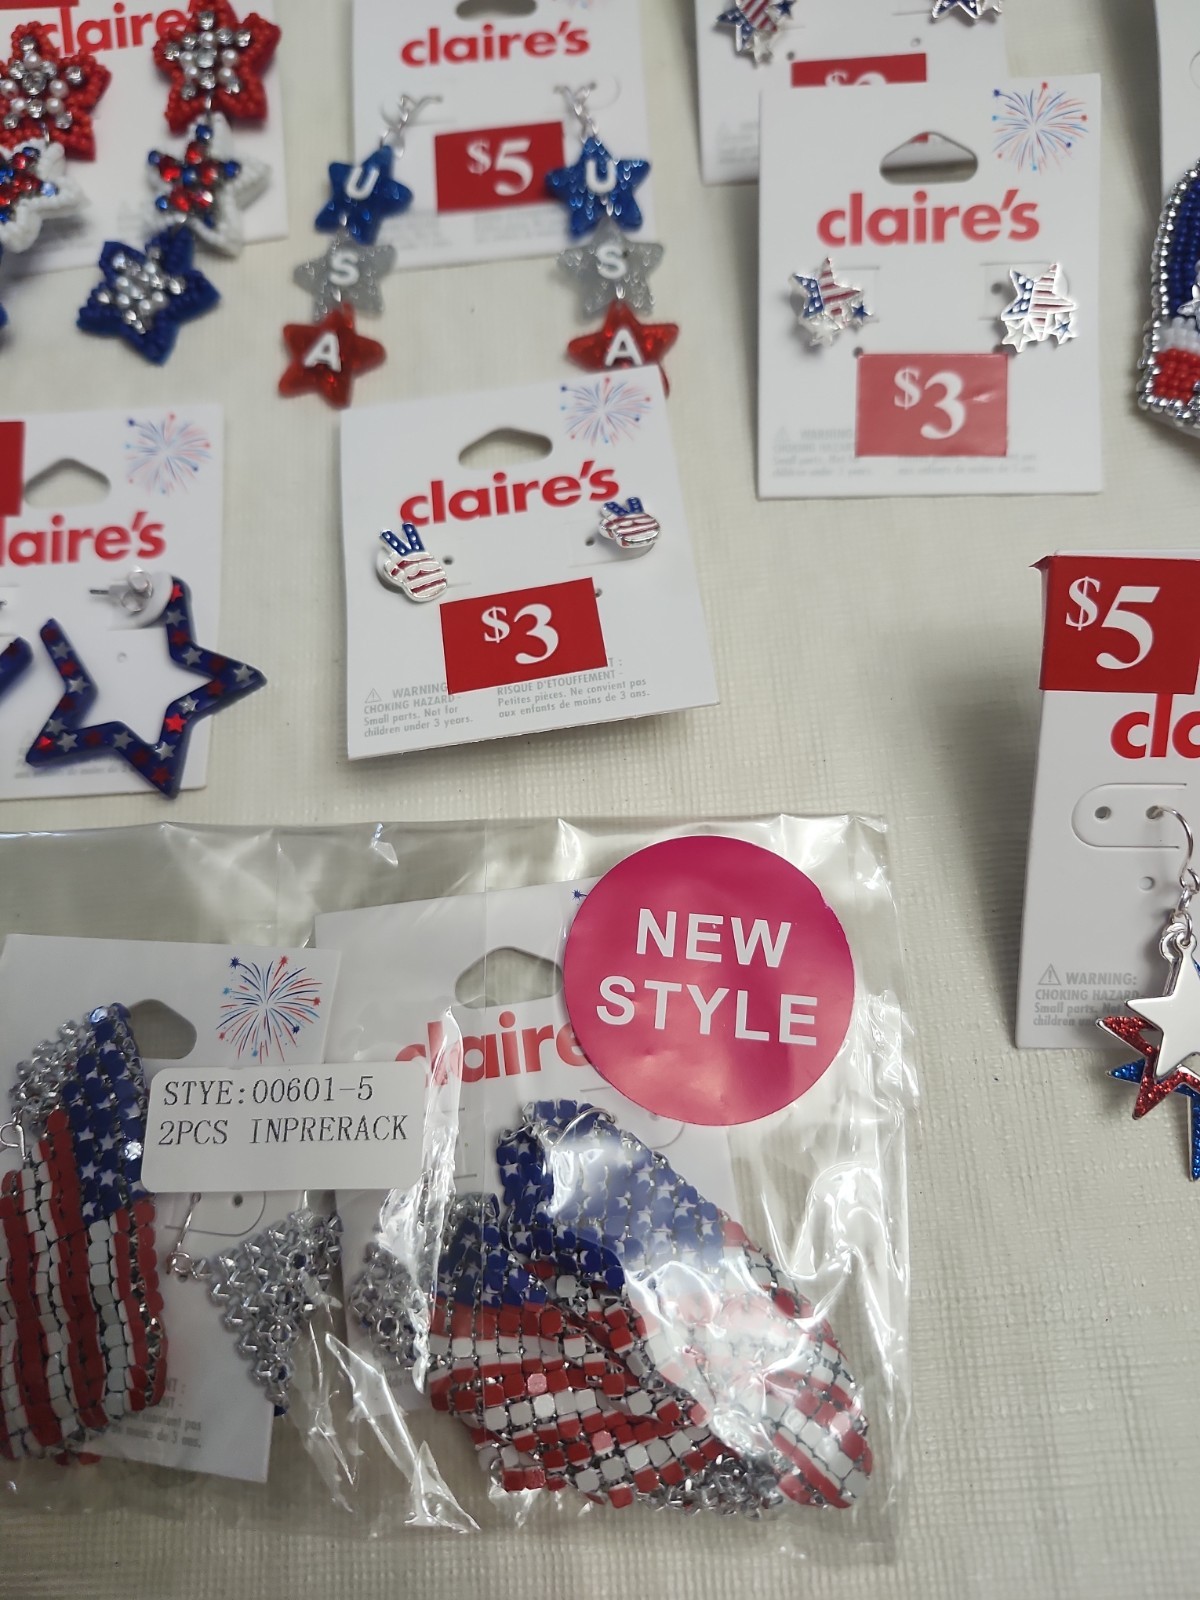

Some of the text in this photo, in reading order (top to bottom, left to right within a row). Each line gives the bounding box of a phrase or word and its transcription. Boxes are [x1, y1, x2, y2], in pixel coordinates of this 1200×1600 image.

[400, 21, 590, 67] claire's
[466, 139, 534, 195] $5
[817, 188, 1041, 247] claire's
[893, 367, 967, 440] $3
[400, 460, 620, 528] claire's
[481, 603, 560, 666] $3
[1065, 576, 1161, 670] $5
[364, 700, 410, 715] CHOKING
[413, 694, 455, 708] HAZARD
[496, 683, 534, 697] RISQUE
[497, 697, 531, 707] Petites
[570, 686, 584, 697] Ne
[587, 682, 627, 695] convient
[629, 678, 647, 690] pas
[499, 690, 649, 719] aux enfants de moins de 3 ans.
[364, 704, 459, 727] Small parts. Not for
[364, 716, 473, 738] children under 3 years.
[636, 908, 792, 968] NEW
[1065, 971, 1138, 986] WARNING:
[1034, 1002, 1064, 1014] Small
[1066, 1004, 1098, 1017] parts.
[1035, 988, 1089, 1001] CHOKING
[596, 975, 818, 1046] STYLE
[1032, 1014, 1076, 1026] children
[158, 1114, 409, 1146] 2PCS INPRERACK
